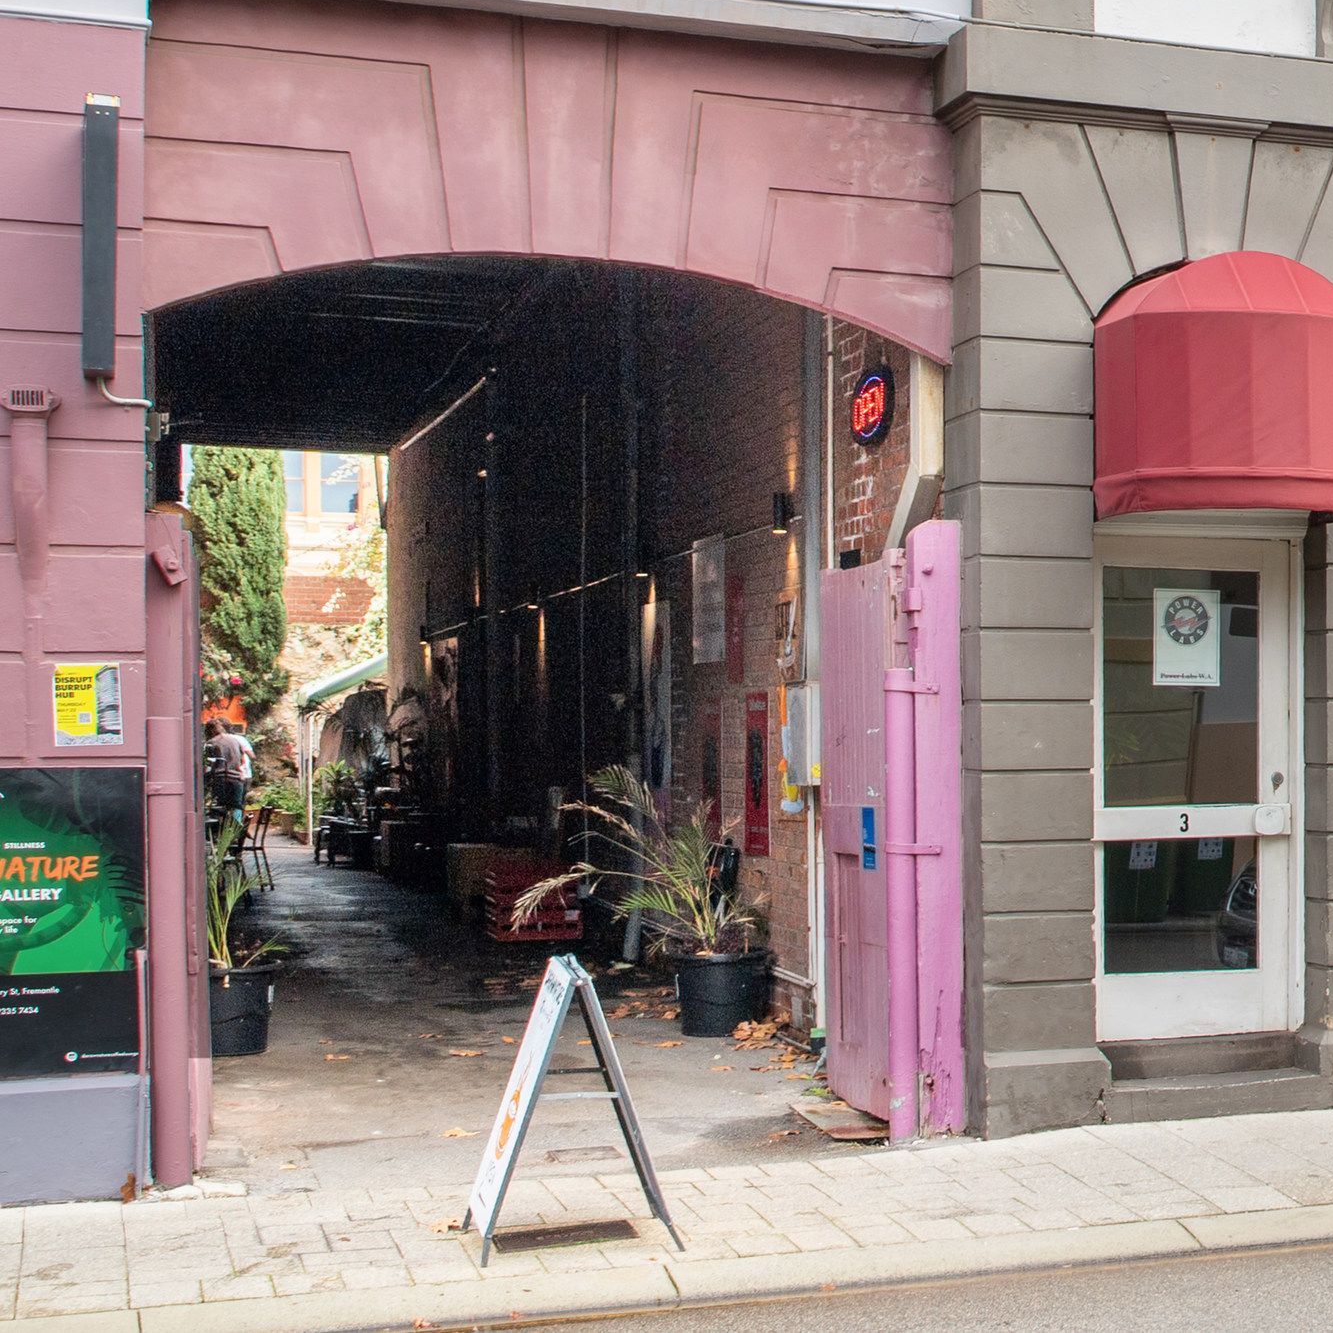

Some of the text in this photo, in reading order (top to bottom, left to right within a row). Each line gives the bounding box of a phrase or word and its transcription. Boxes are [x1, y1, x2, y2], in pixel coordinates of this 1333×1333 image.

[853, 381, 884, 431] OPEN
[1168, 598, 1204, 615] POWER
[1170, 629, 1204, 644] LABS
[55, 676, 93, 684] DISRUPT
[1179, 813, 1189, 832] 3
[4, 841, 45, 849] STILLNESS
[0, 887, 63, 901] ALLERY
[24, 916, 37, 924] for
[5, 926, 18, 934] life
[22, 986, 60, 995] Fremantle
[18, 1006, 39, 1015] 7434
